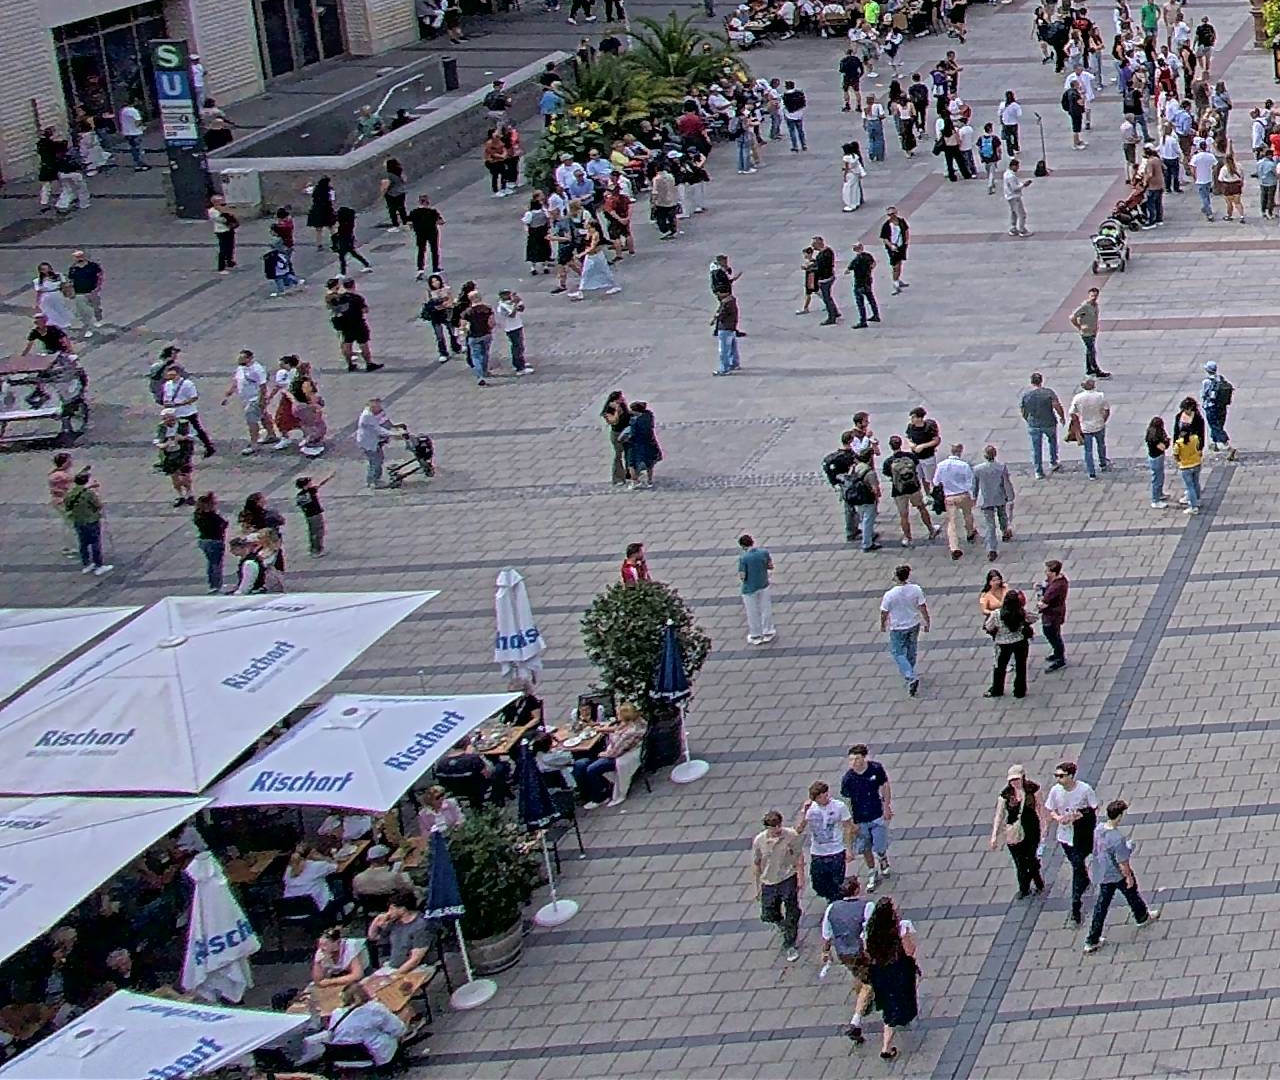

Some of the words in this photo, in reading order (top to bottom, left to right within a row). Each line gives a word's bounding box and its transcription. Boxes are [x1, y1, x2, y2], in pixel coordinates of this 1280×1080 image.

[157, 44, 179, 68] S
[163, 73, 182, 96] U
[222, 639, 296, 691] Rischart
[34, 727, 137, 748] Rischart
[383, 708, 466, 772] Rischart
[248, 769, 354, 794] Rischart
